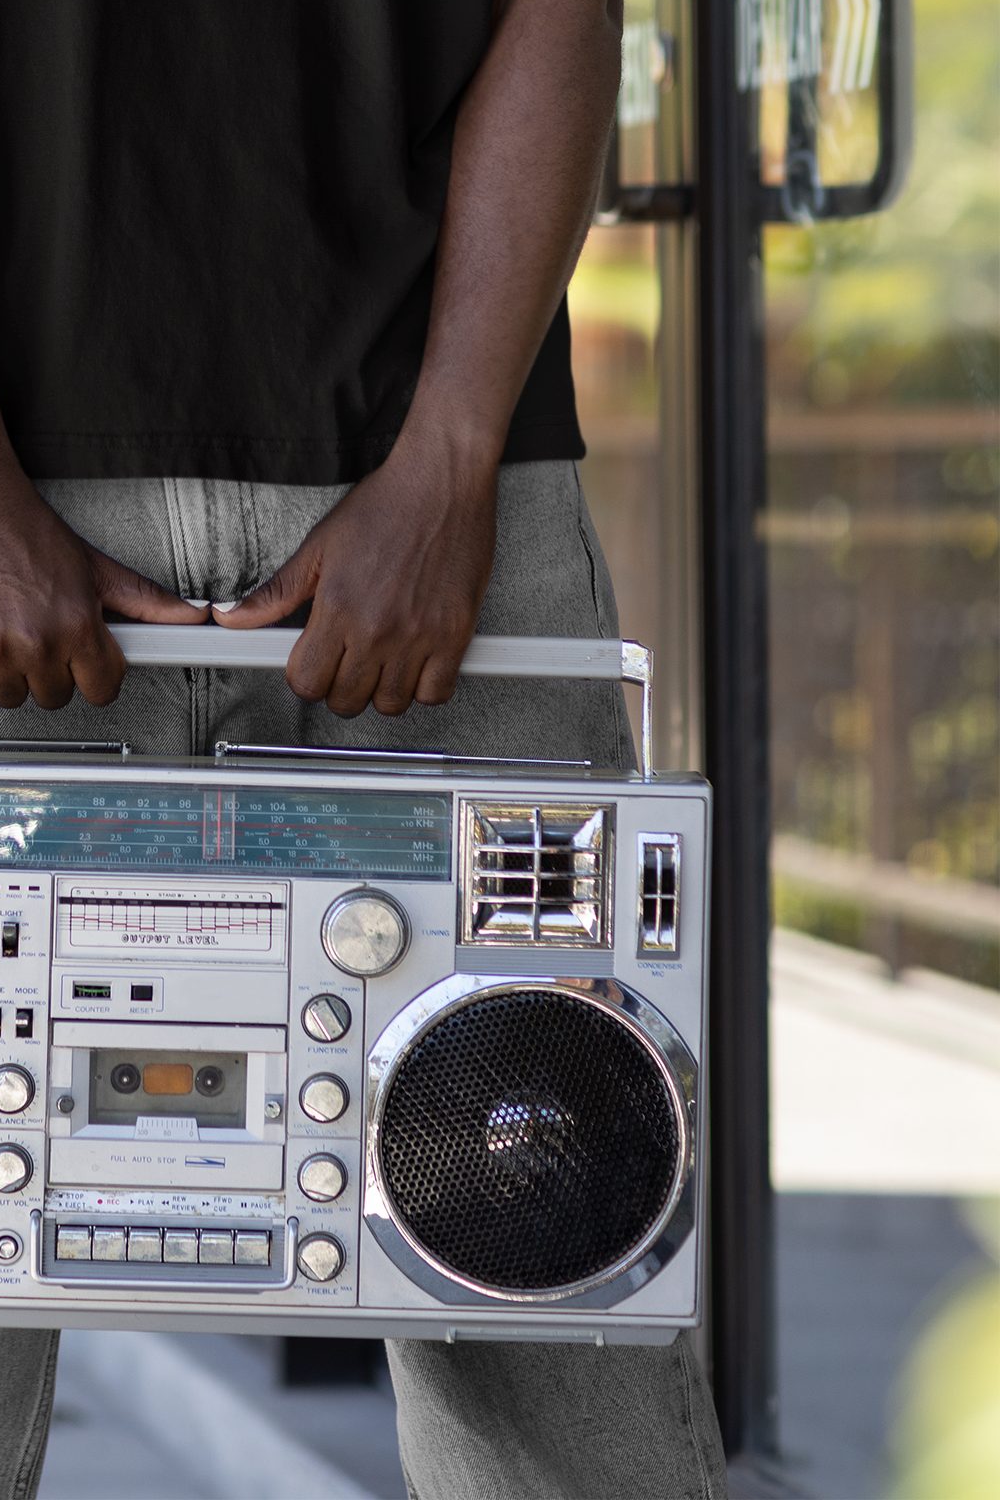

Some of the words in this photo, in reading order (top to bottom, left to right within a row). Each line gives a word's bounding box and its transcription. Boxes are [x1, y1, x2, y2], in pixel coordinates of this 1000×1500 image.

[92, 797, 105, 806] 88
[137, 798, 150, 808] 92
[179, 799, 191, 809] 96
[224, 801, 240, 810] 100
[270, 802, 286, 811] 104
[321, 804, 338, 813] 108
[413, 807, 435, 816] MHz
[77, 810, 87, 818] 53
[104, 811, 114, 819] 57
[118, 811, 128, 819] 60
[141, 812, 151, 820] 65
[187, 813, 198, 821] 80
[416, 819, 434, 828] KHz
[413, 841, 434, 850] MHz
[288, 850, 297, 858] 18
[413, 854, 434, 862] MHz
[422, 929, 450, 937] TUNING
[121, 933, 171, 944] OUTPUT
[177, 935, 219, 945] LEVEL
[637, 962, 683, 970] CONDENSER
[15, 987, 39, 995] MODE
[307, 1046, 348, 1054] FUNCTION
[110, 1154, 127, 1163] FULL
[132, 1155, 152, 1163] AUTO
[157, 1156, 177, 1164] STOP
[311, 1207, 334, 1215] BASS
[306, 1287, 339, 1295] TREBLE
